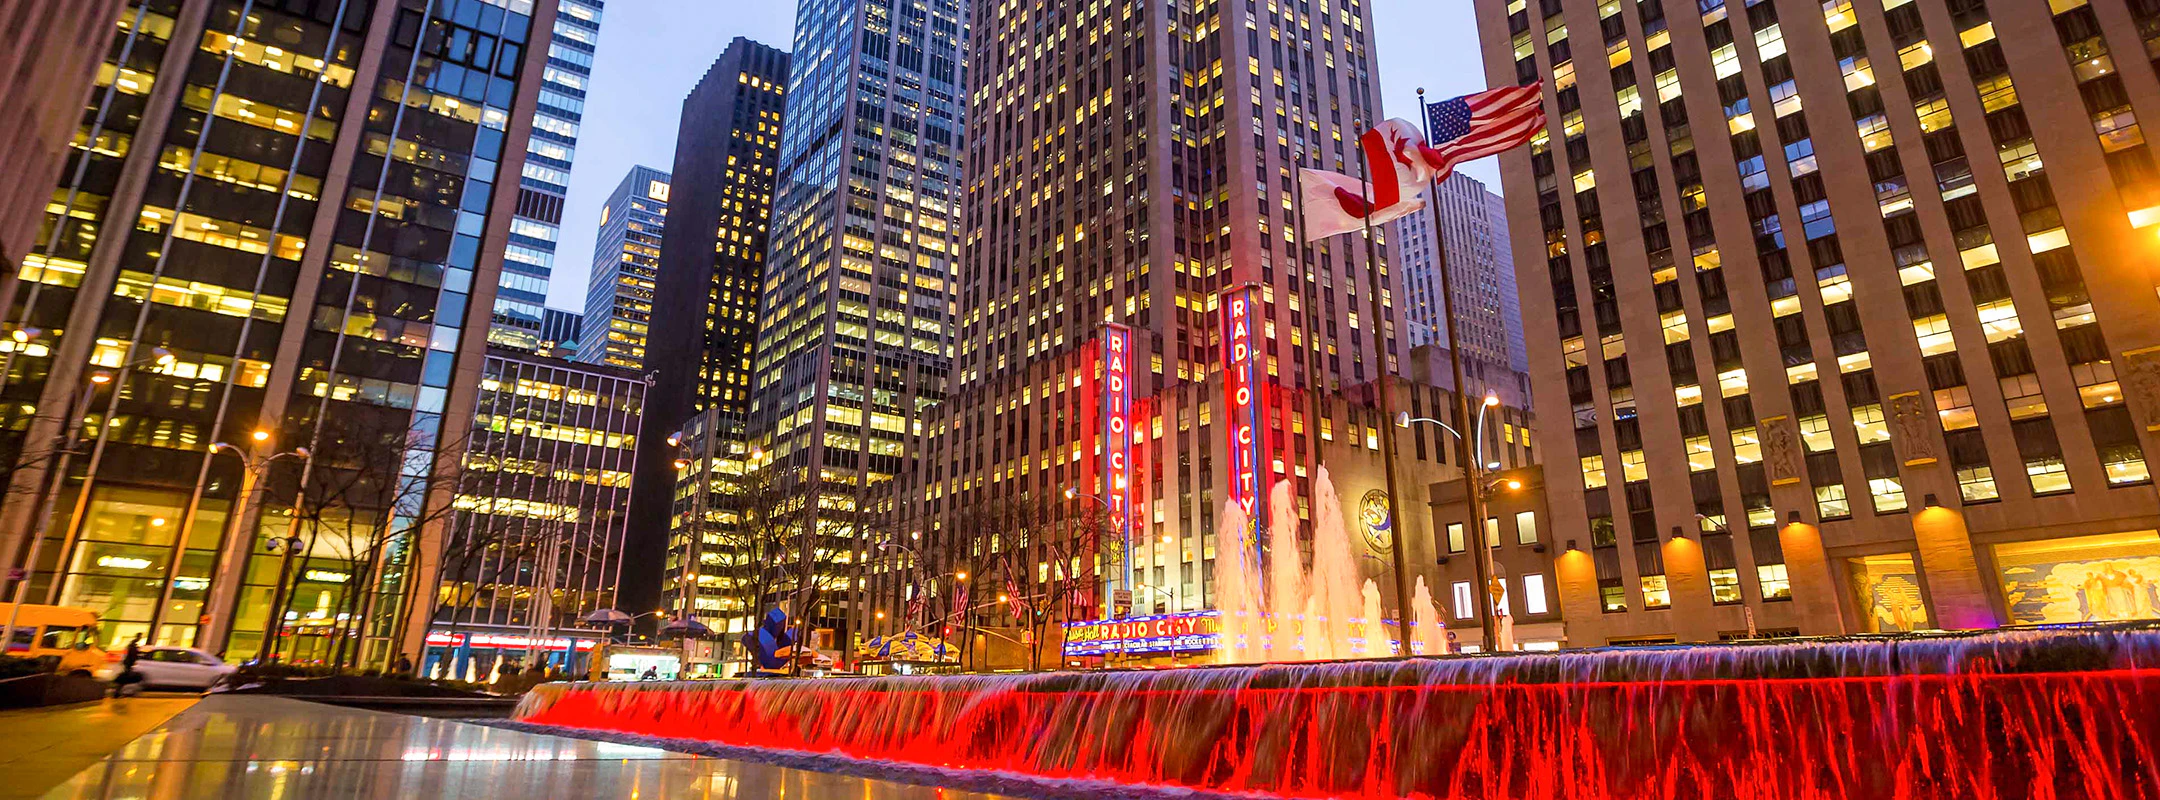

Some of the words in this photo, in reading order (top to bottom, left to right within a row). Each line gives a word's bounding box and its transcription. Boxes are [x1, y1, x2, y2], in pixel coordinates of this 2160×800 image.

[1110, 335, 1124, 433] RADIO
[1233, 299, 1250, 405] RADIO
[1239, 427, 1254, 515] CITY
[1101, 622, 1148, 640] RADIO
